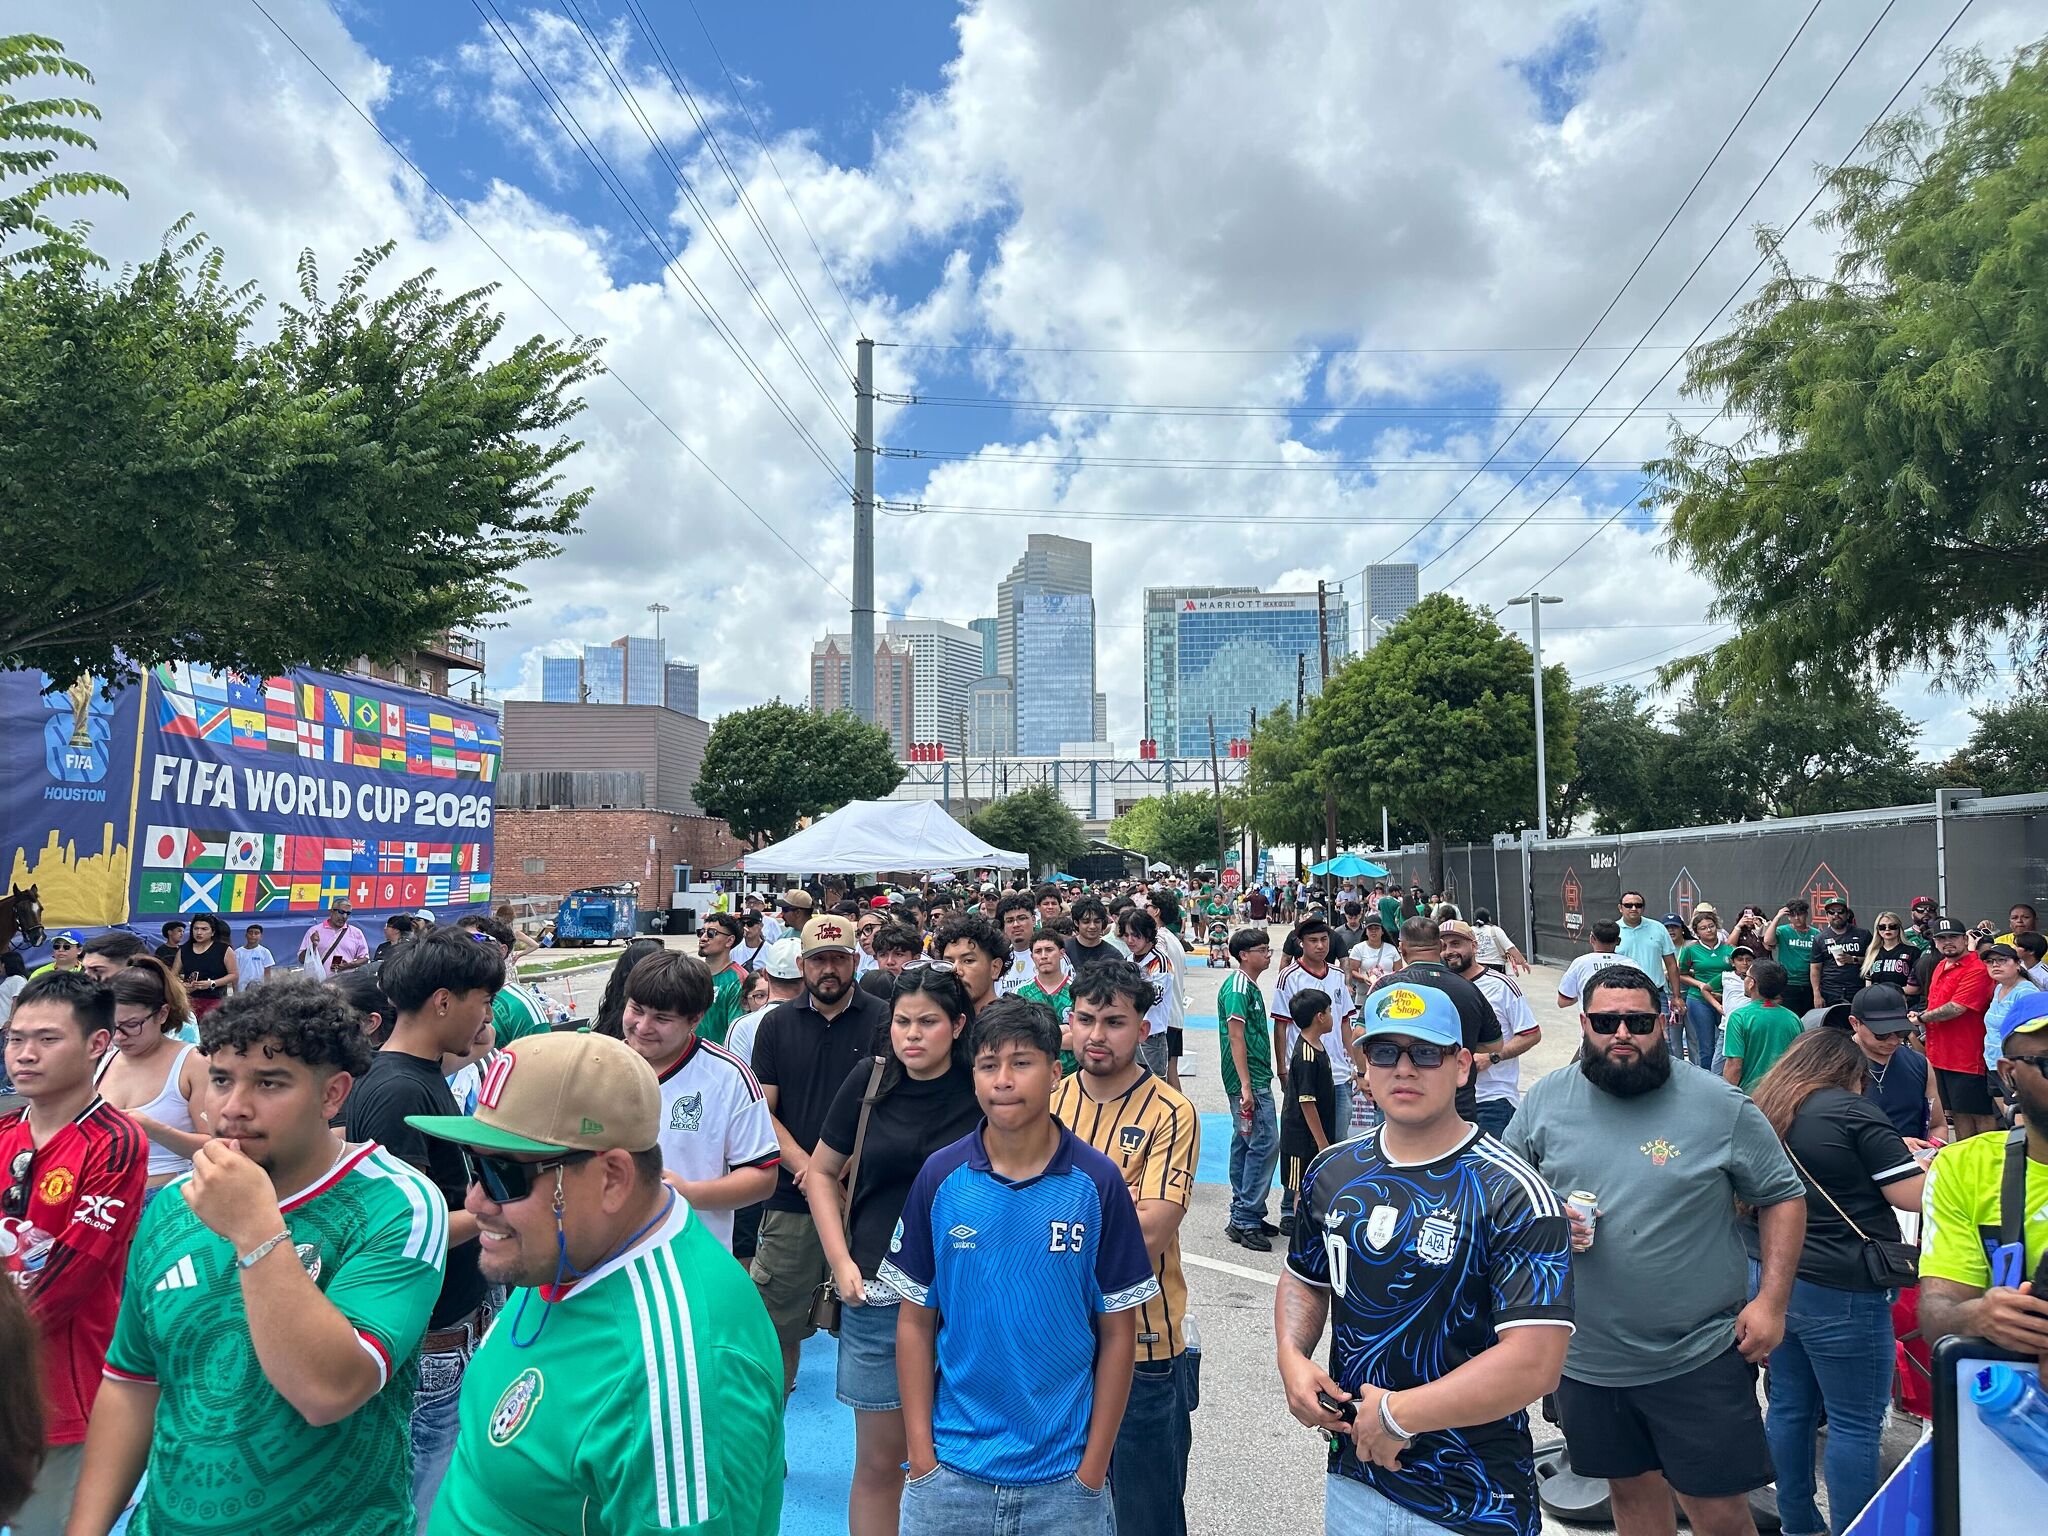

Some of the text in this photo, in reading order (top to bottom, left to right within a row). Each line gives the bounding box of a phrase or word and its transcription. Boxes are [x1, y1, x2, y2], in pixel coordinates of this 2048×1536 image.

[1200, 600, 1261, 609] MARRIOTT
[66, 754, 93, 770] FIFA
[44, 786, 106, 802] HOUSTON
[150, 754, 491, 828] FIFA WORLD CUP 2026
[1222, 874, 1240, 883] STOP
[1788, 938, 1813, 948] MÉXIC
[1001, 979, 1028, 989] Emir
[1396, 990, 1417, 999] Bass
[1395, 998, 1411, 1006] Pro
[1396, 1006, 1422, 1016] Shops
[1050, 1221, 1086, 1253] ES
[1425, 1231, 1445, 1253] AFA
[953, 1240, 976, 1249] umbro
